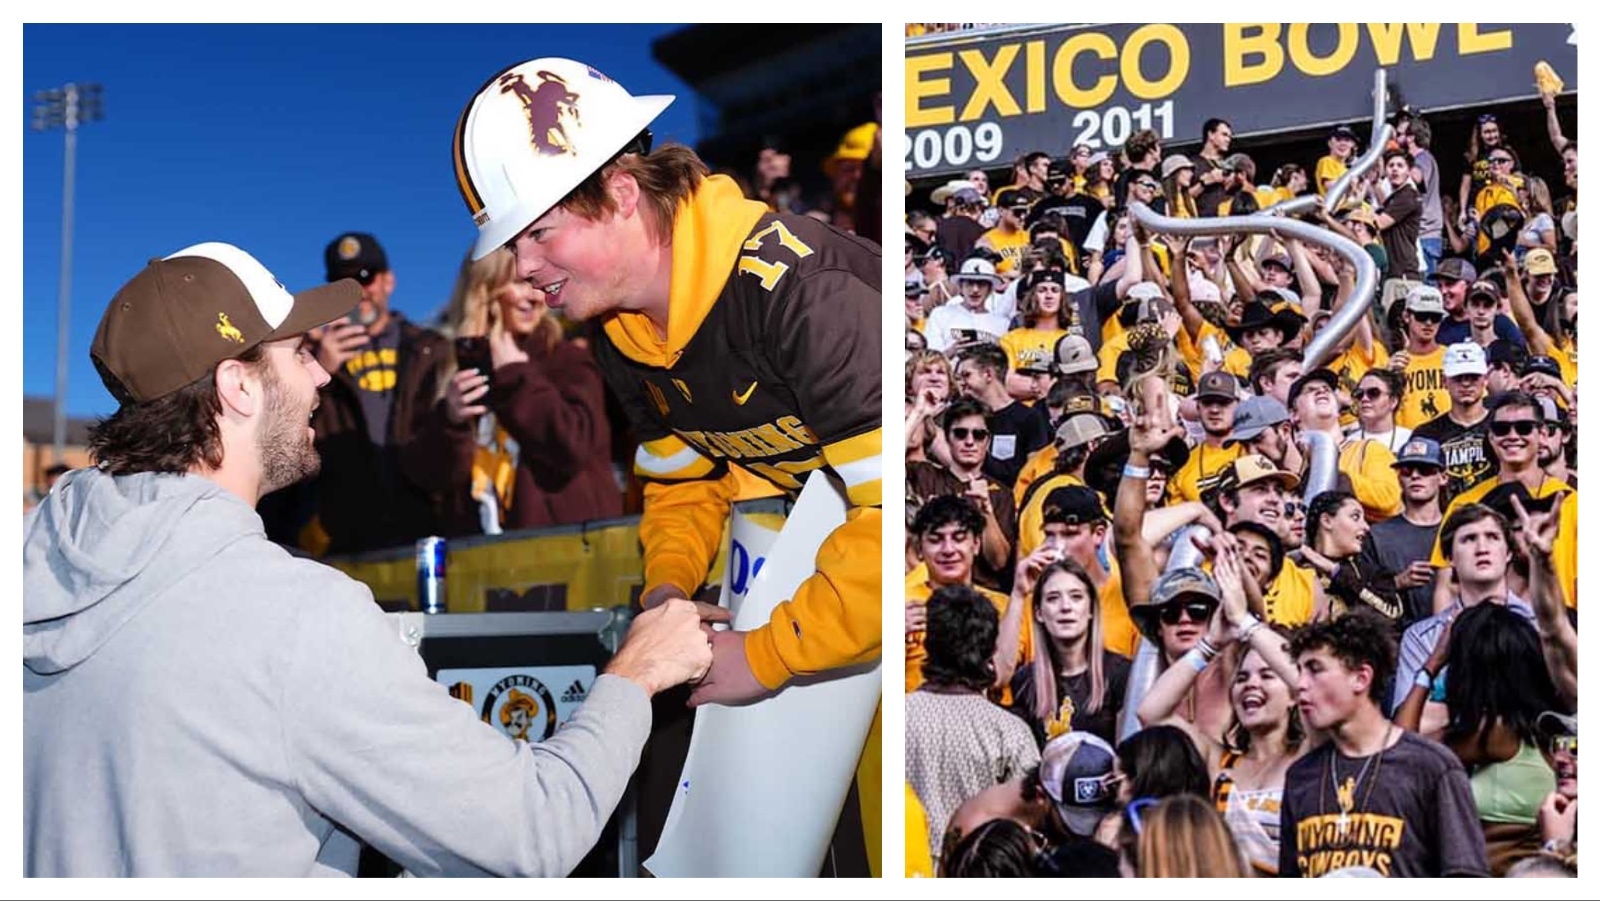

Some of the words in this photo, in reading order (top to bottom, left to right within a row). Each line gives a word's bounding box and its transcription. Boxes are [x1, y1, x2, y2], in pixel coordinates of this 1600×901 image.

[1072, 100, 1174, 148] 2011
[738, 220, 814, 291] 17
[491, 676, 547, 698] WYOMING
